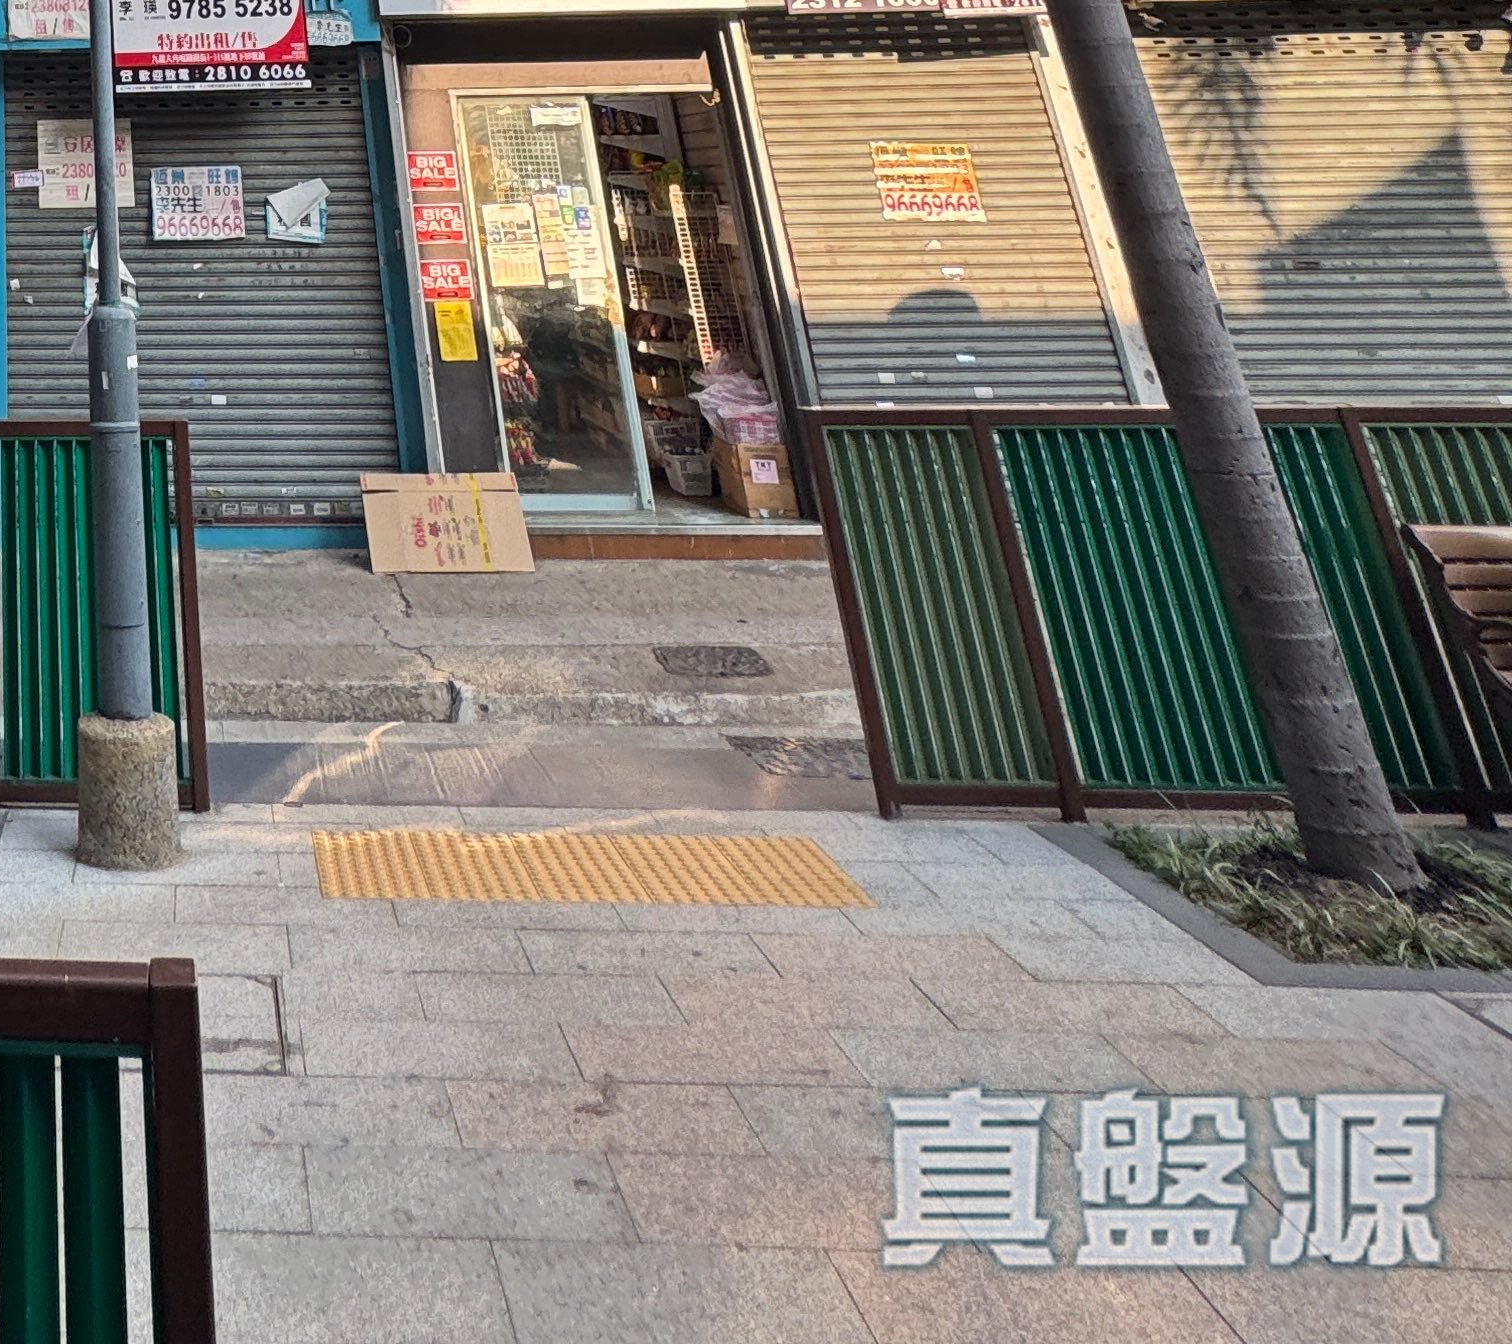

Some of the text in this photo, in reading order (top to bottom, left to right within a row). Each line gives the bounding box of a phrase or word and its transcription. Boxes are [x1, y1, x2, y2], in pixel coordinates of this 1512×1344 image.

[204, 65, 252, 81] 2810
[258, 63, 307, 80] 6066
[415, 156, 447, 168] BIG
[410, 167, 456, 180] SALE
[156, 185, 239, 197] 2300 1803
[422, 208, 453, 221] BIG
[157, 215, 244, 237] 96669668
[416, 219, 465, 232] SALE
[429, 264, 461, 277] BIG
[422, 276, 471, 289] SALE
